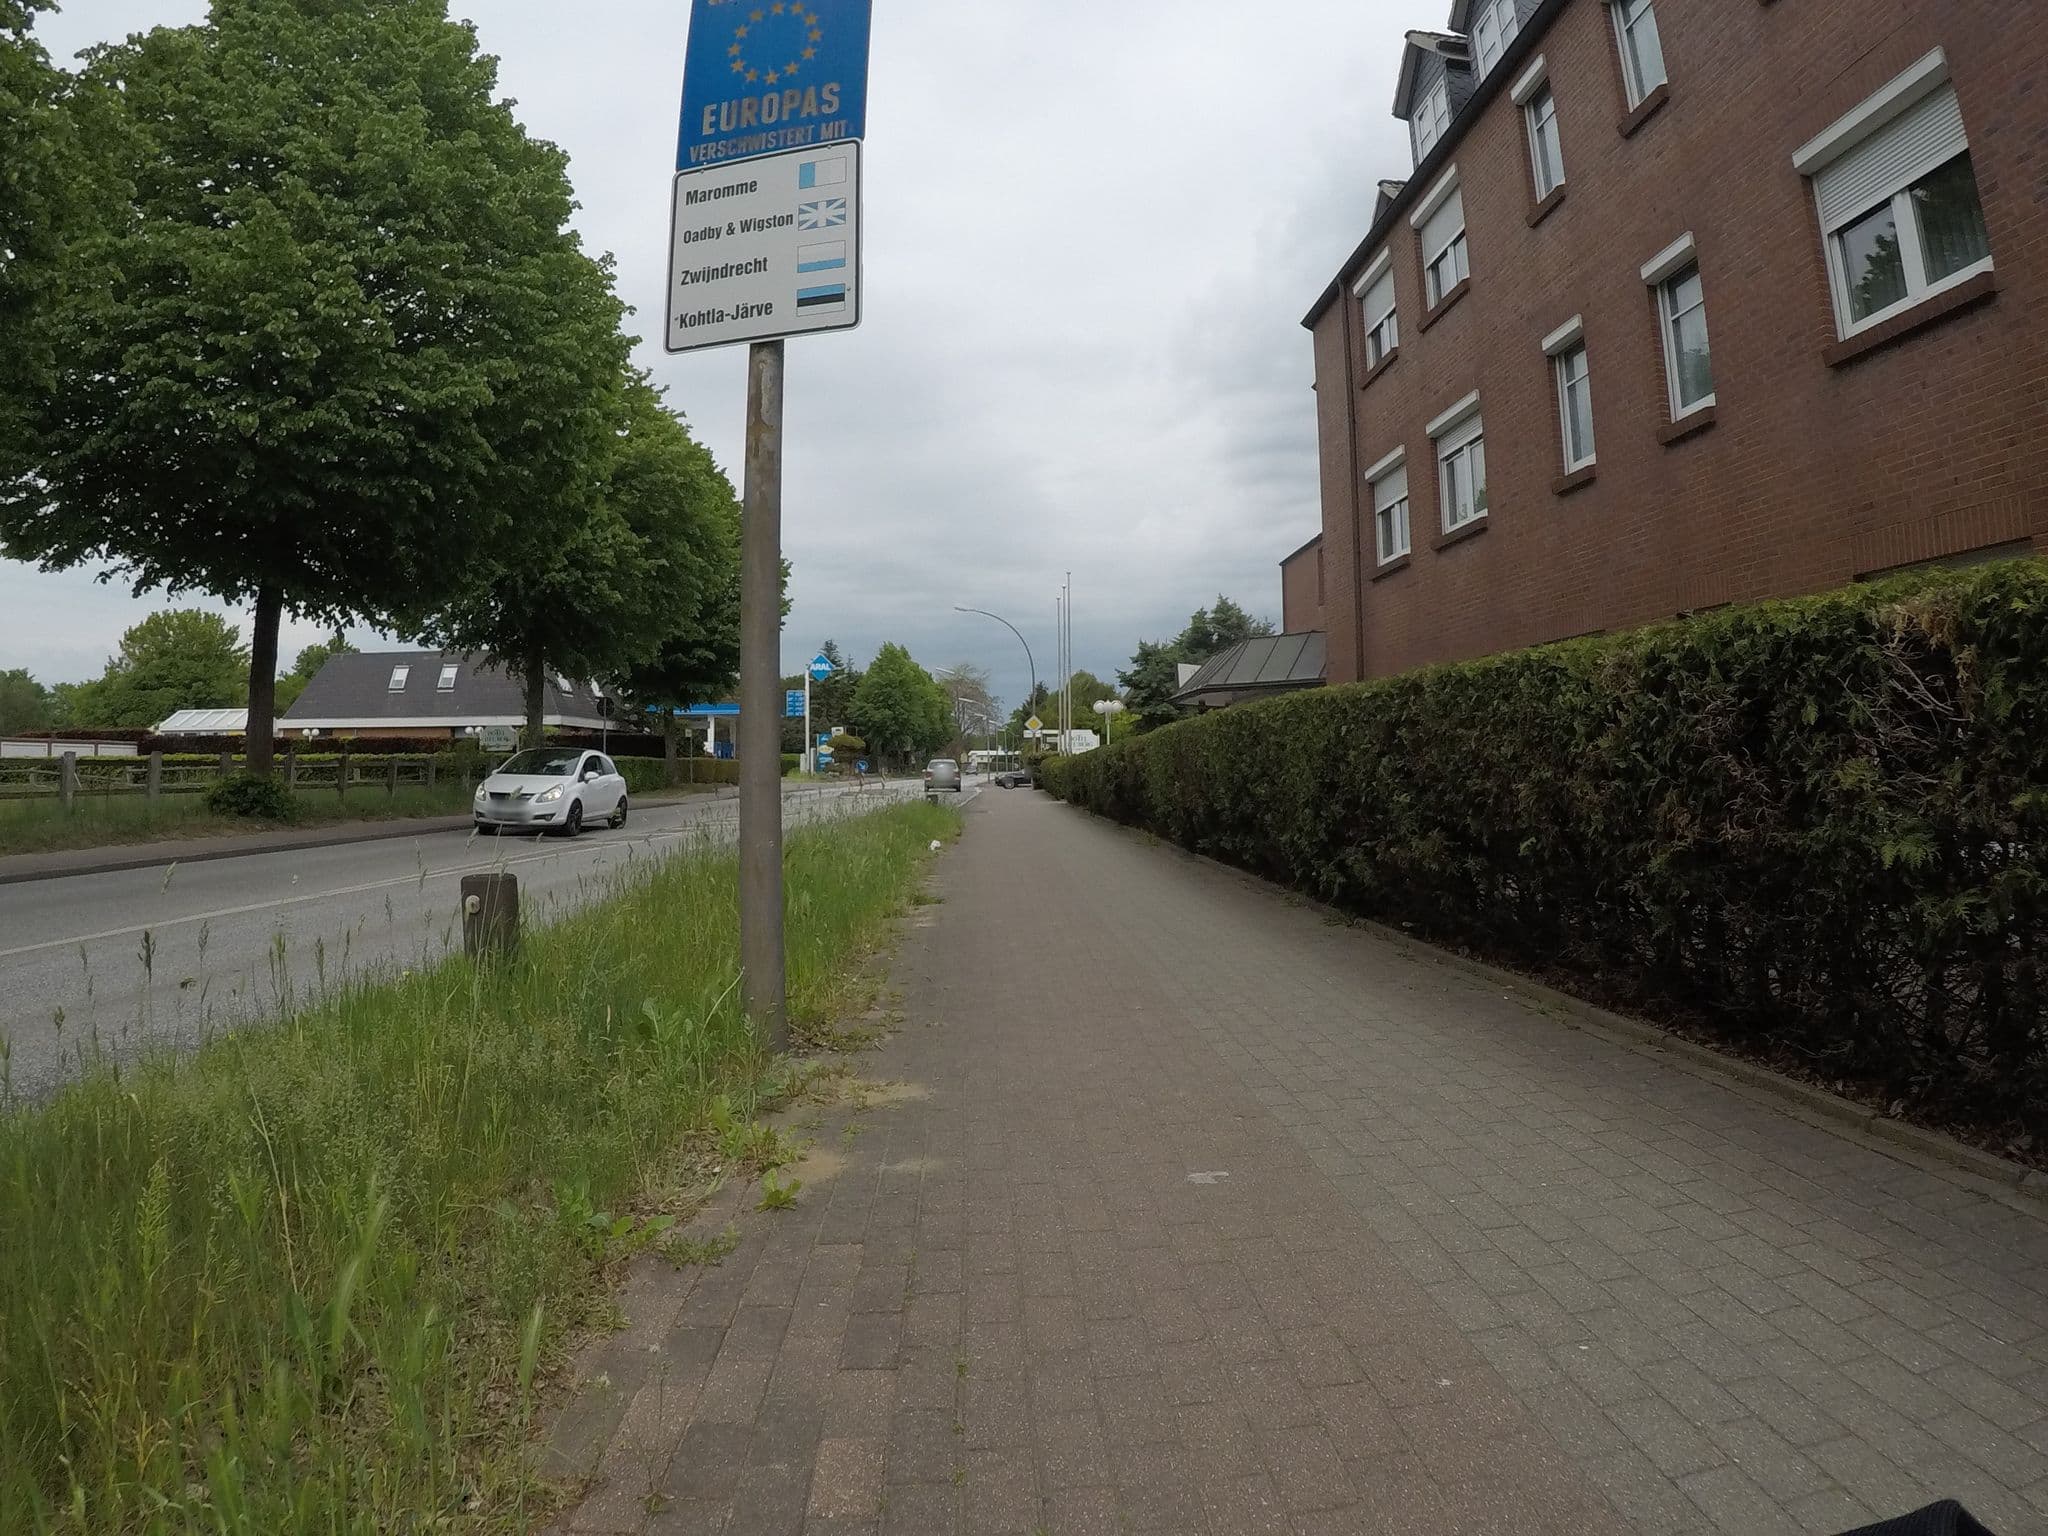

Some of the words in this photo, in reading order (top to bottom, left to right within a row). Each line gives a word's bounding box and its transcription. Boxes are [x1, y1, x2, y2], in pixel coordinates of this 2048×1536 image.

[702, 83, 841, 136] EUROPAS
[690, 125, 813, 163] VERSCHWISTERT
[820, 119, 848, 140] MIT
[685, 180, 758, 206] Maromme
[683, 226, 722, 245] Oadby
[726, 222, 736, 236] &
[740, 213, 794, 234] Wigston
[681, 257, 768, 286] Zwijndrecht
[679, 301, 773, 329] Kohtla-Järve
[810, 663, 832, 671] ARAL
